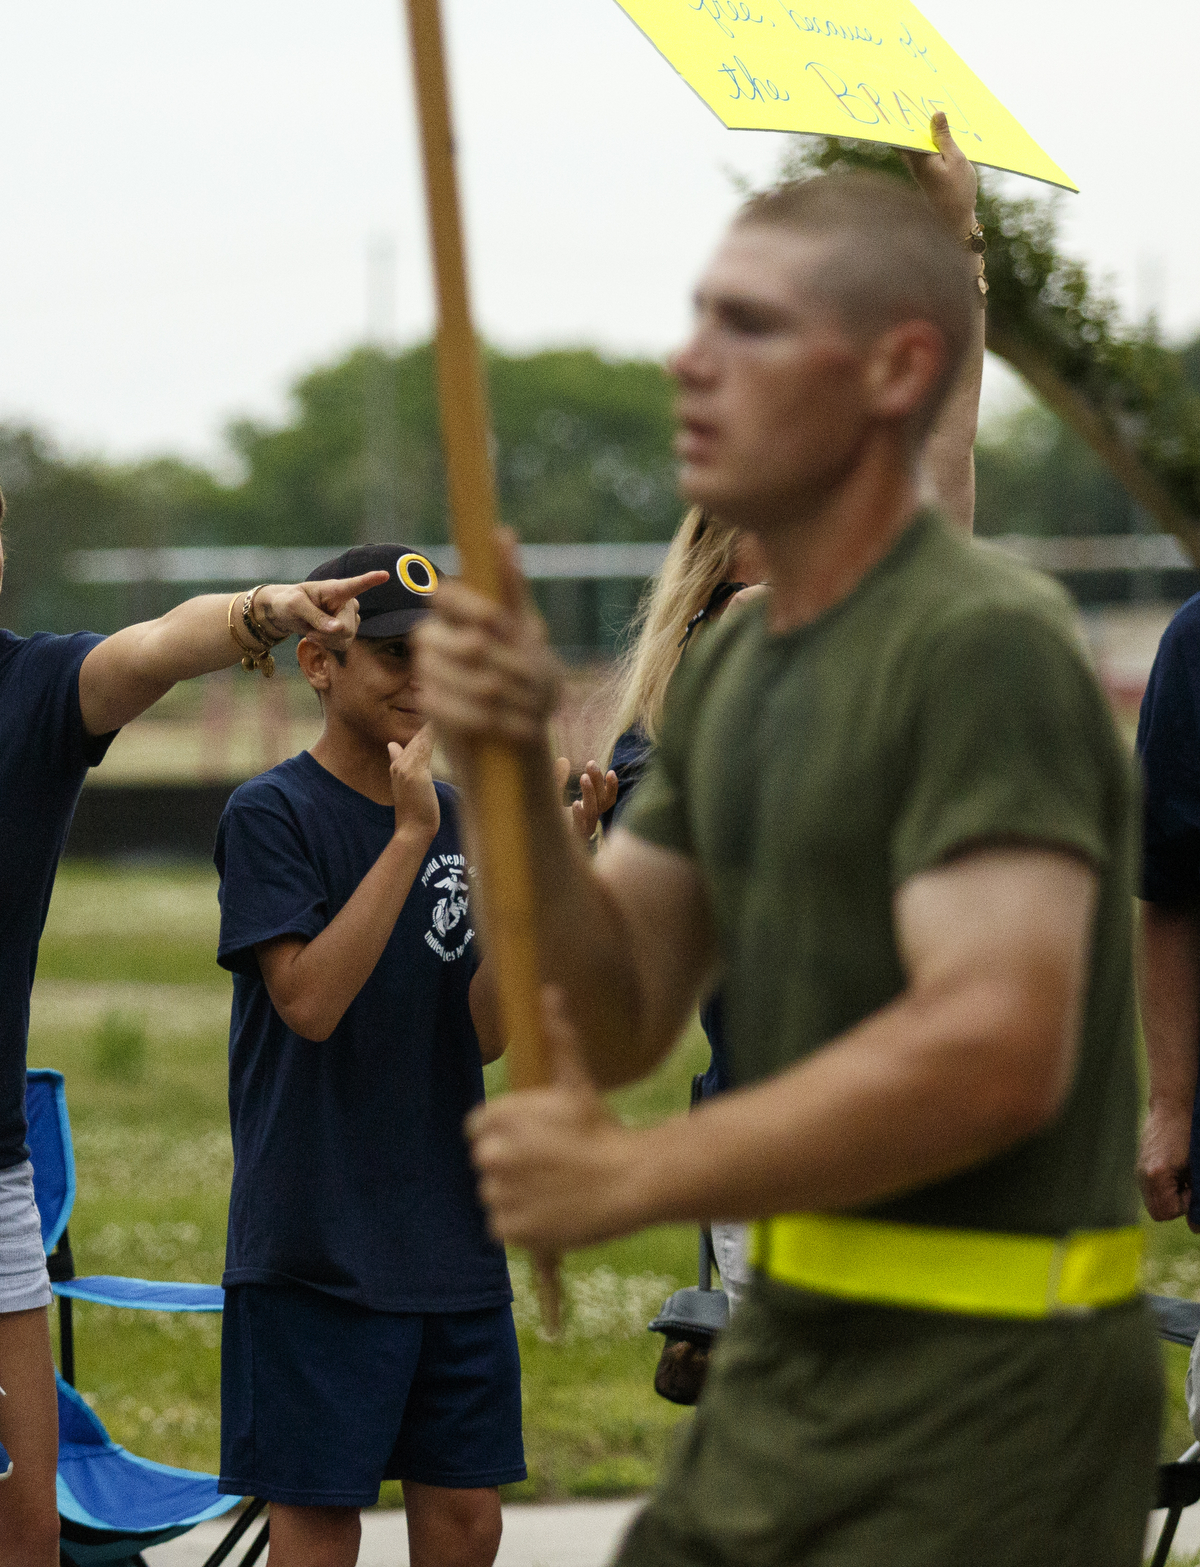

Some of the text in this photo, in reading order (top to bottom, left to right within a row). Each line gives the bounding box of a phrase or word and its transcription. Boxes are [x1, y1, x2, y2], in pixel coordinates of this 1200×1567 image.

[777, 0, 883, 46] because
[898, 22, 938, 73] of
[717, 55, 791, 103] the
